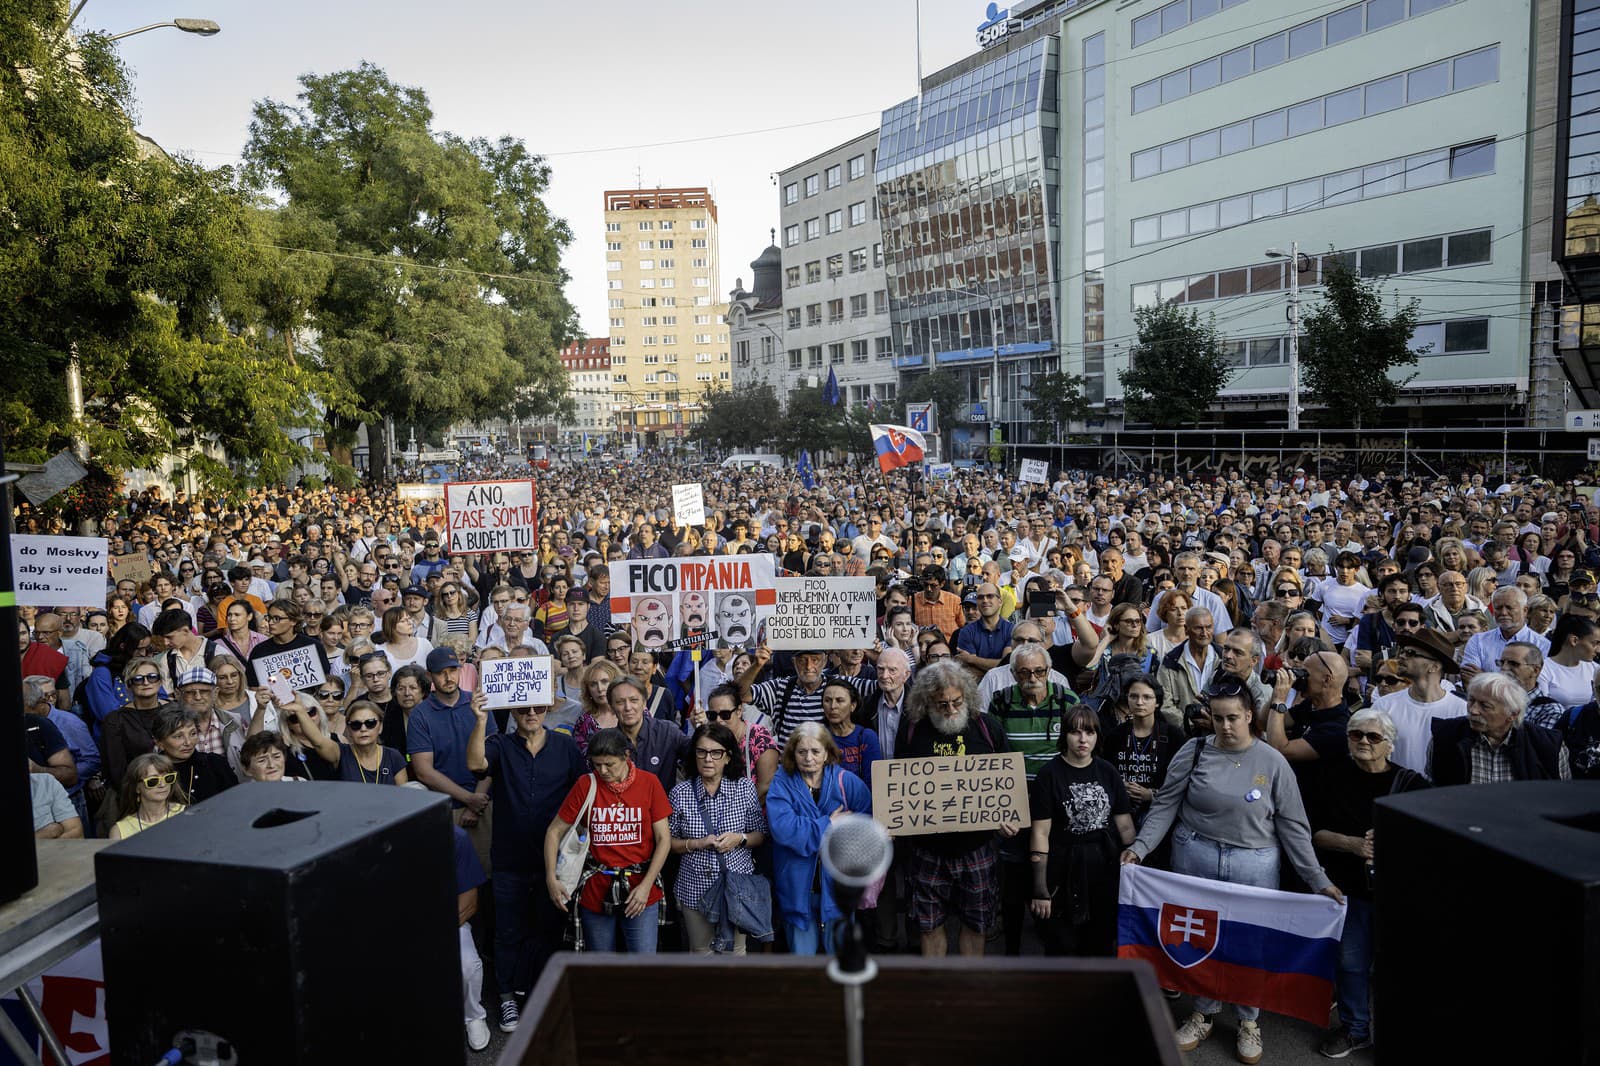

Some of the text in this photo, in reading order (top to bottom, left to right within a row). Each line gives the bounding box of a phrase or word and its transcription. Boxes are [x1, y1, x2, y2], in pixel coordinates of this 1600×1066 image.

[466, 486, 505, 506] ÁNO,
[452, 506, 534, 529] ZASE SOM TU
[452, 533, 462, 550] A
[466, 530, 507, 550] BUDEM
[20, 546, 100, 559] do Moskvy
[20, 565, 103, 575] aby si vedel
[18, 582, 50, 591] fúka
[779, 589, 830, 603] NEPRÍJEMNÝ
[832, 592, 838, 602] A
[776, 604, 788, 614] KO
[793, 604, 840, 614] HEMEROIDY
[796, 614, 809, 626] UŽ
[813, 616, 825, 626] DO
[830, 616, 861, 626] PRDELE
[801, 628, 826, 639] BOLO
[833, 628, 855, 638] FICA
[262, 648, 309, 665] SLOVENSKO
[266, 663, 275, 672] JE
[290, 674, 318, 688] SSIA
[508, 692, 527, 702] RF
[888, 761, 934, 777] FICO
[954, 756, 1014, 772] LÚZER
[887, 781, 936, 798] FICO
[956, 777, 1015, 792] RUSKO
[889, 800, 937, 814] SVK
[962, 794, 1012, 809] FICO
[592, 803, 642, 822] ZVÝŠILI
[888, 814, 937, 830] SVK
[960, 807, 1021, 824] EURÓPA
[593, 823, 637, 832] SEBE PLATY
[619, 832, 638, 841] DANE
